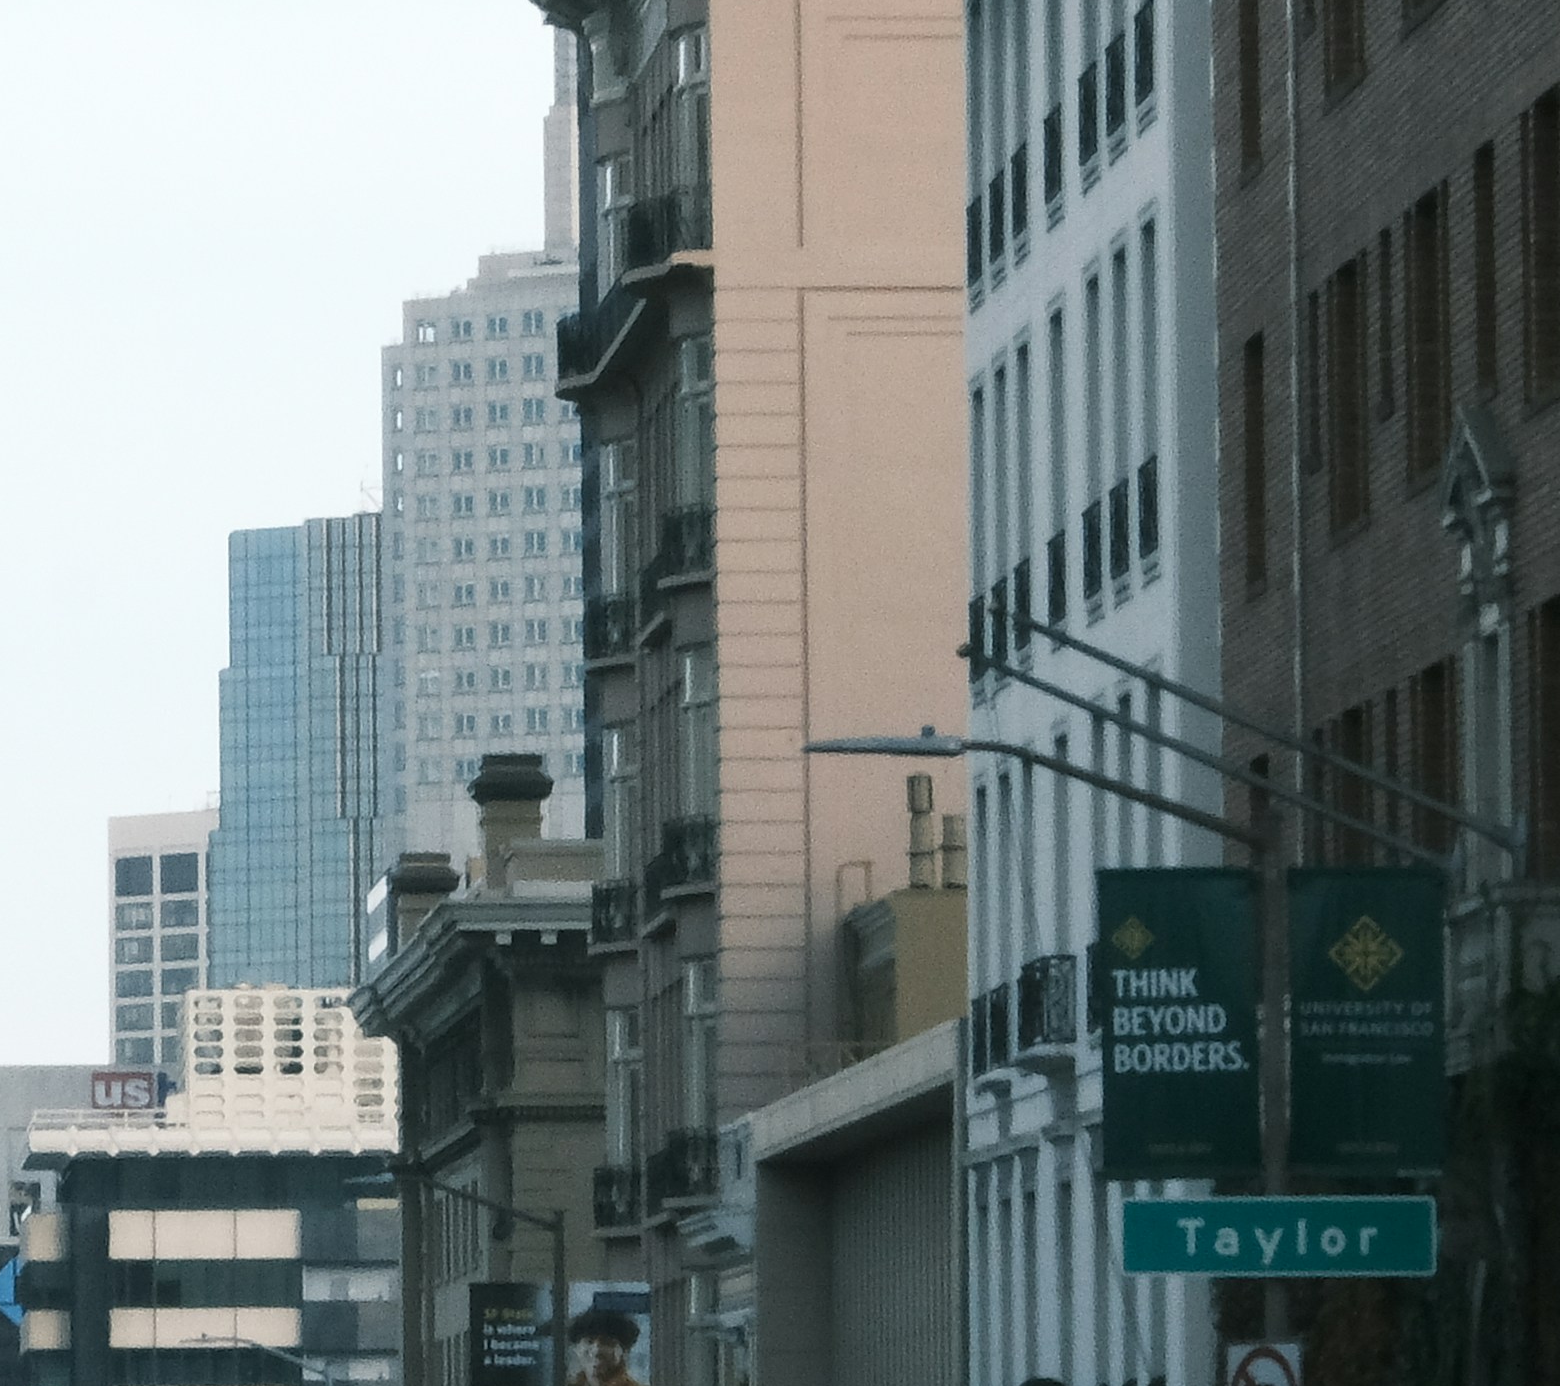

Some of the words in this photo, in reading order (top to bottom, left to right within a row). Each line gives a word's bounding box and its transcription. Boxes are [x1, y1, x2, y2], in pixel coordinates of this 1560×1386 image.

[1112, 968, 1198, 997] THINK
[1113, 1004, 1226, 1035] BEYOND
[1300, 1000, 1403, 1015] UNIVERSITY
[1411, 1000, 1432, 1015] OF
[1300, 1021, 1333, 1036] SAN
[1338, 1021, 1434, 1036] FRANCISCO
[1114, 1041, 1250, 1073] BORDERS.
[1177, 1216, 1377, 1266] Taylor
